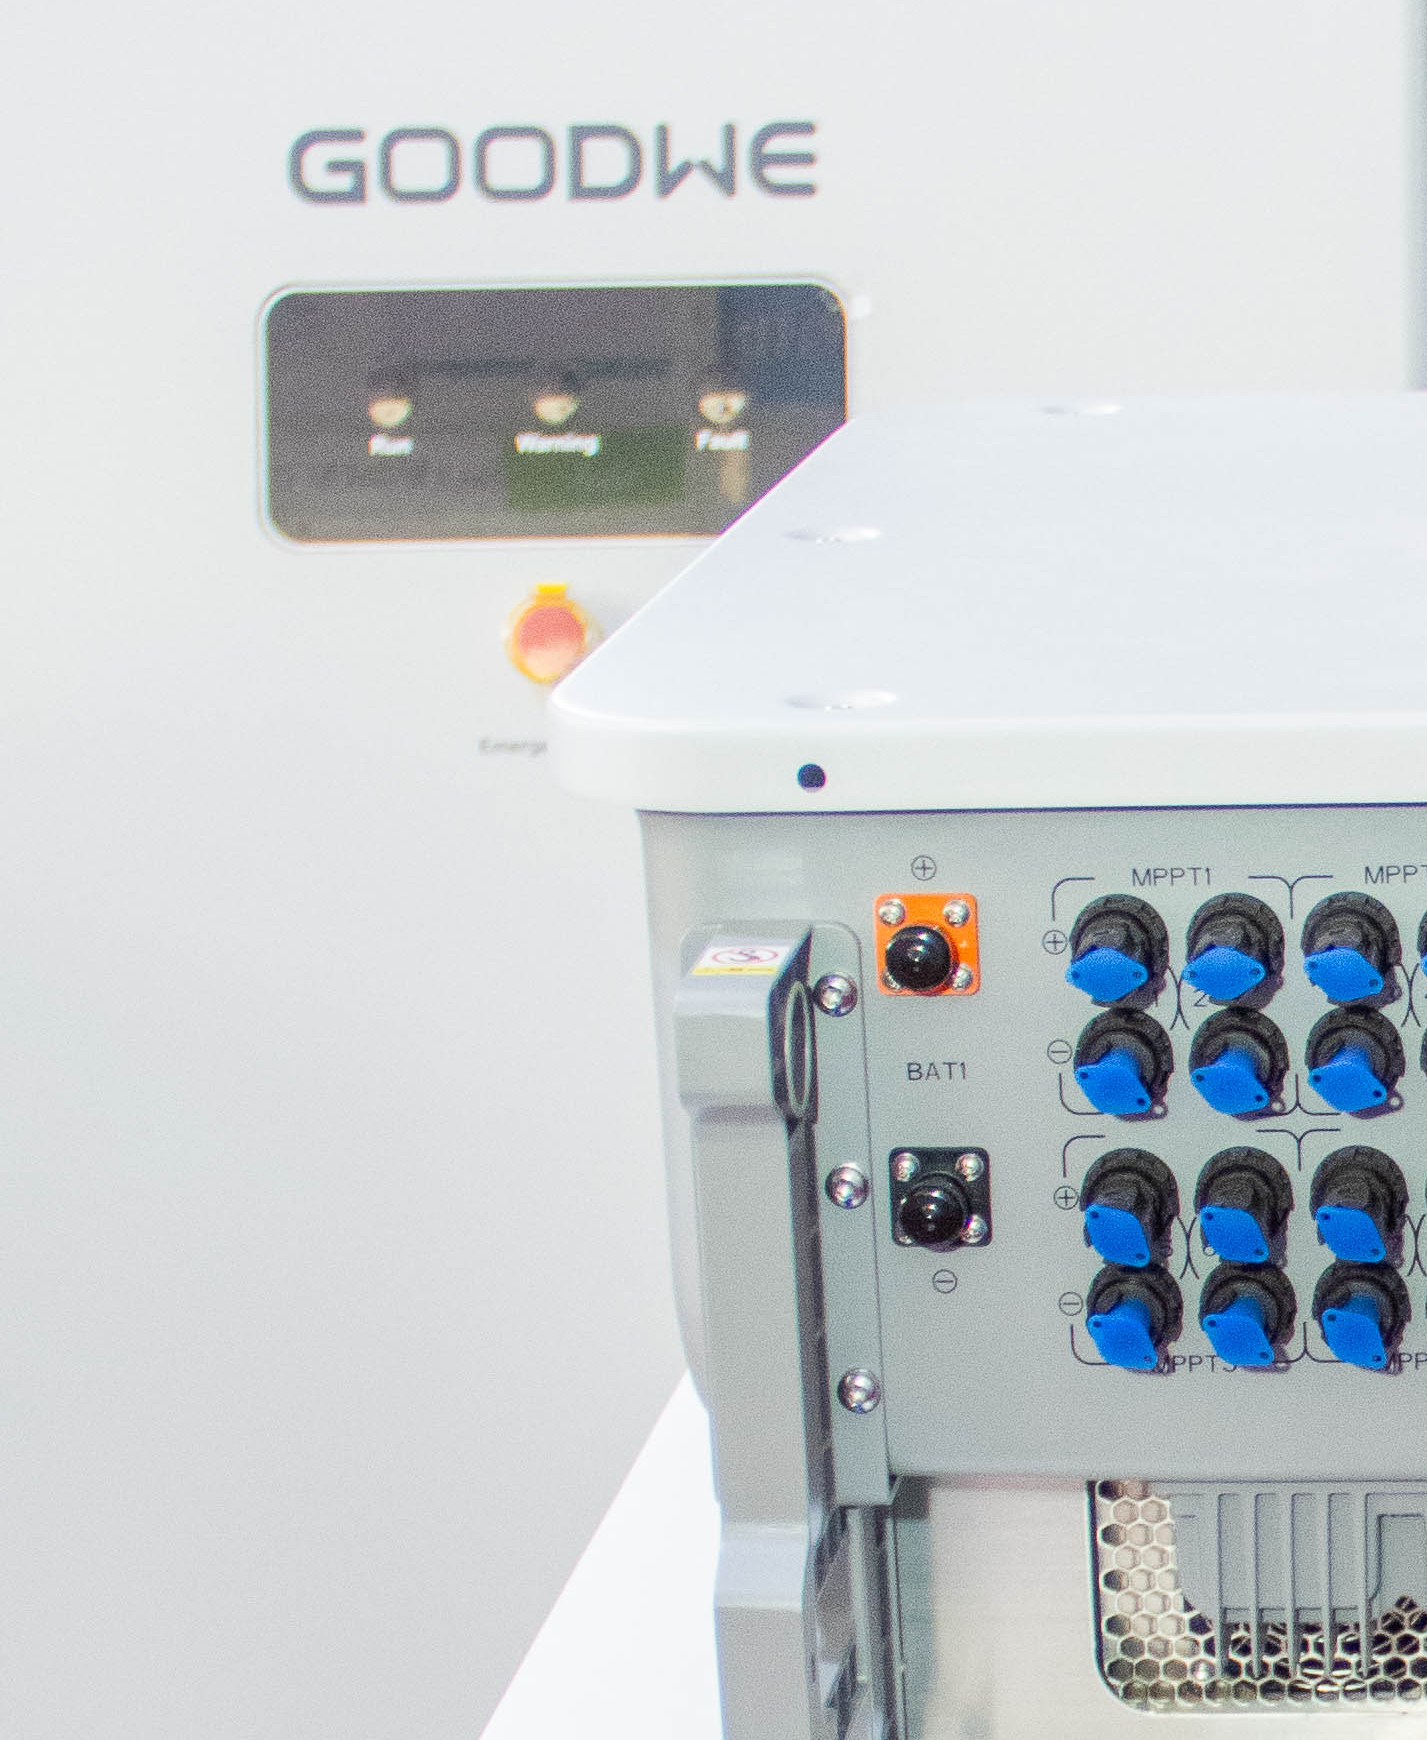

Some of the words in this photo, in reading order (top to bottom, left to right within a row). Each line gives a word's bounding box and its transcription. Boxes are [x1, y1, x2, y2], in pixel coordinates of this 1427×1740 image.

[289, 121, 817, 205] GOODWE
[1131, 866, 1211, 887] MPPT1
[906, 1061, 966, 1082] BAT1
